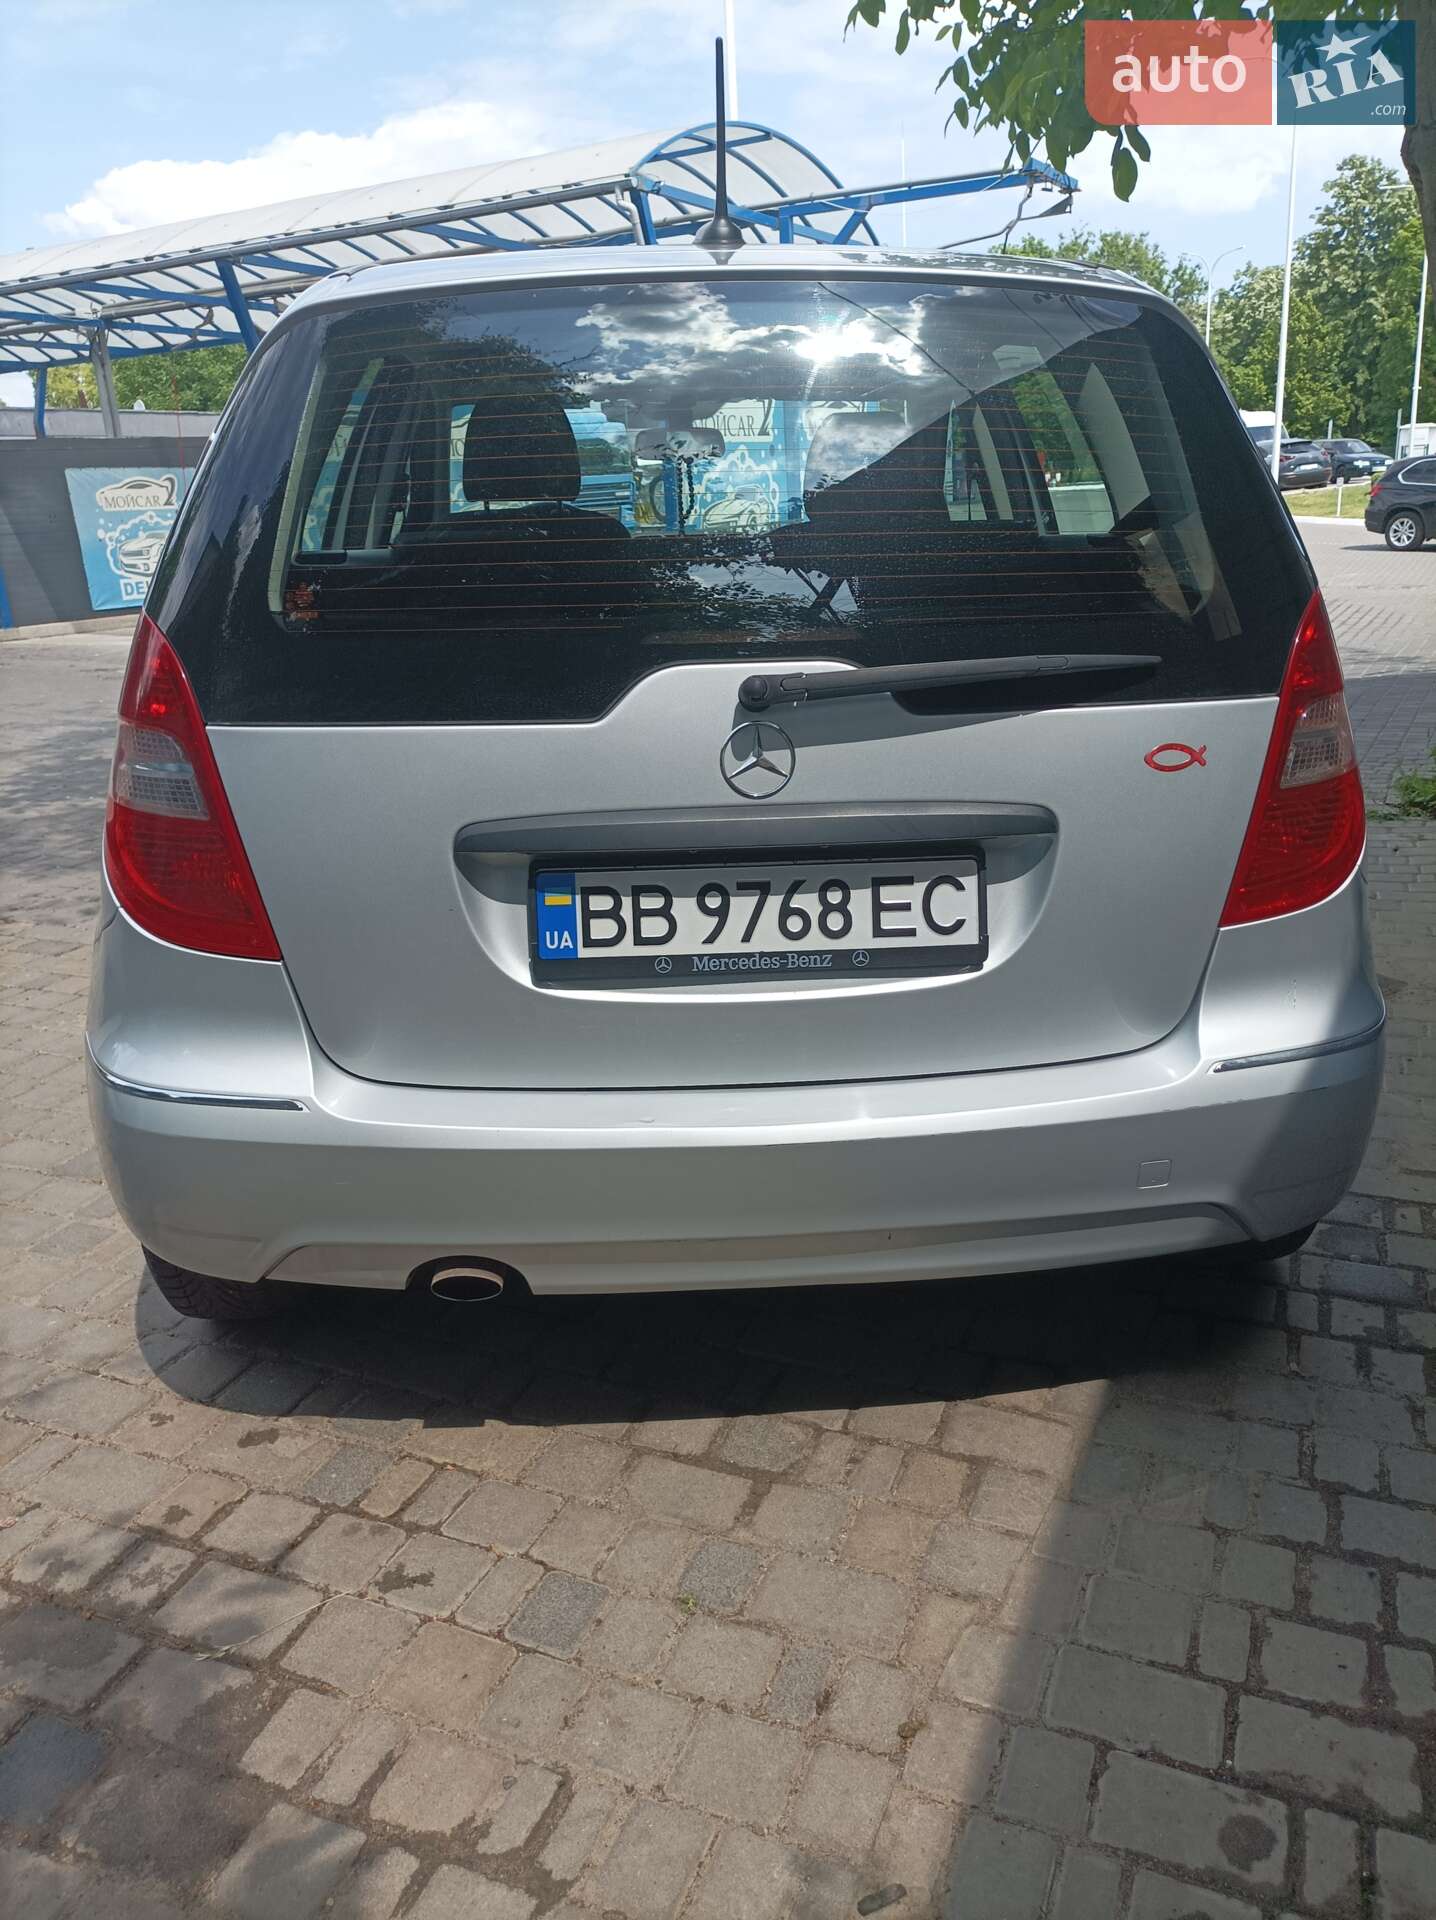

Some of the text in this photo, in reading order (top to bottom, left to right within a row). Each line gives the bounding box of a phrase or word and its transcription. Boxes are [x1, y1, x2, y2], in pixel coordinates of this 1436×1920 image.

[580, 874, 967, 949] BB 9768 EC
[545, 930, 574, 950] UA
[691, 952, 833, 973] Mercedes-Benz
